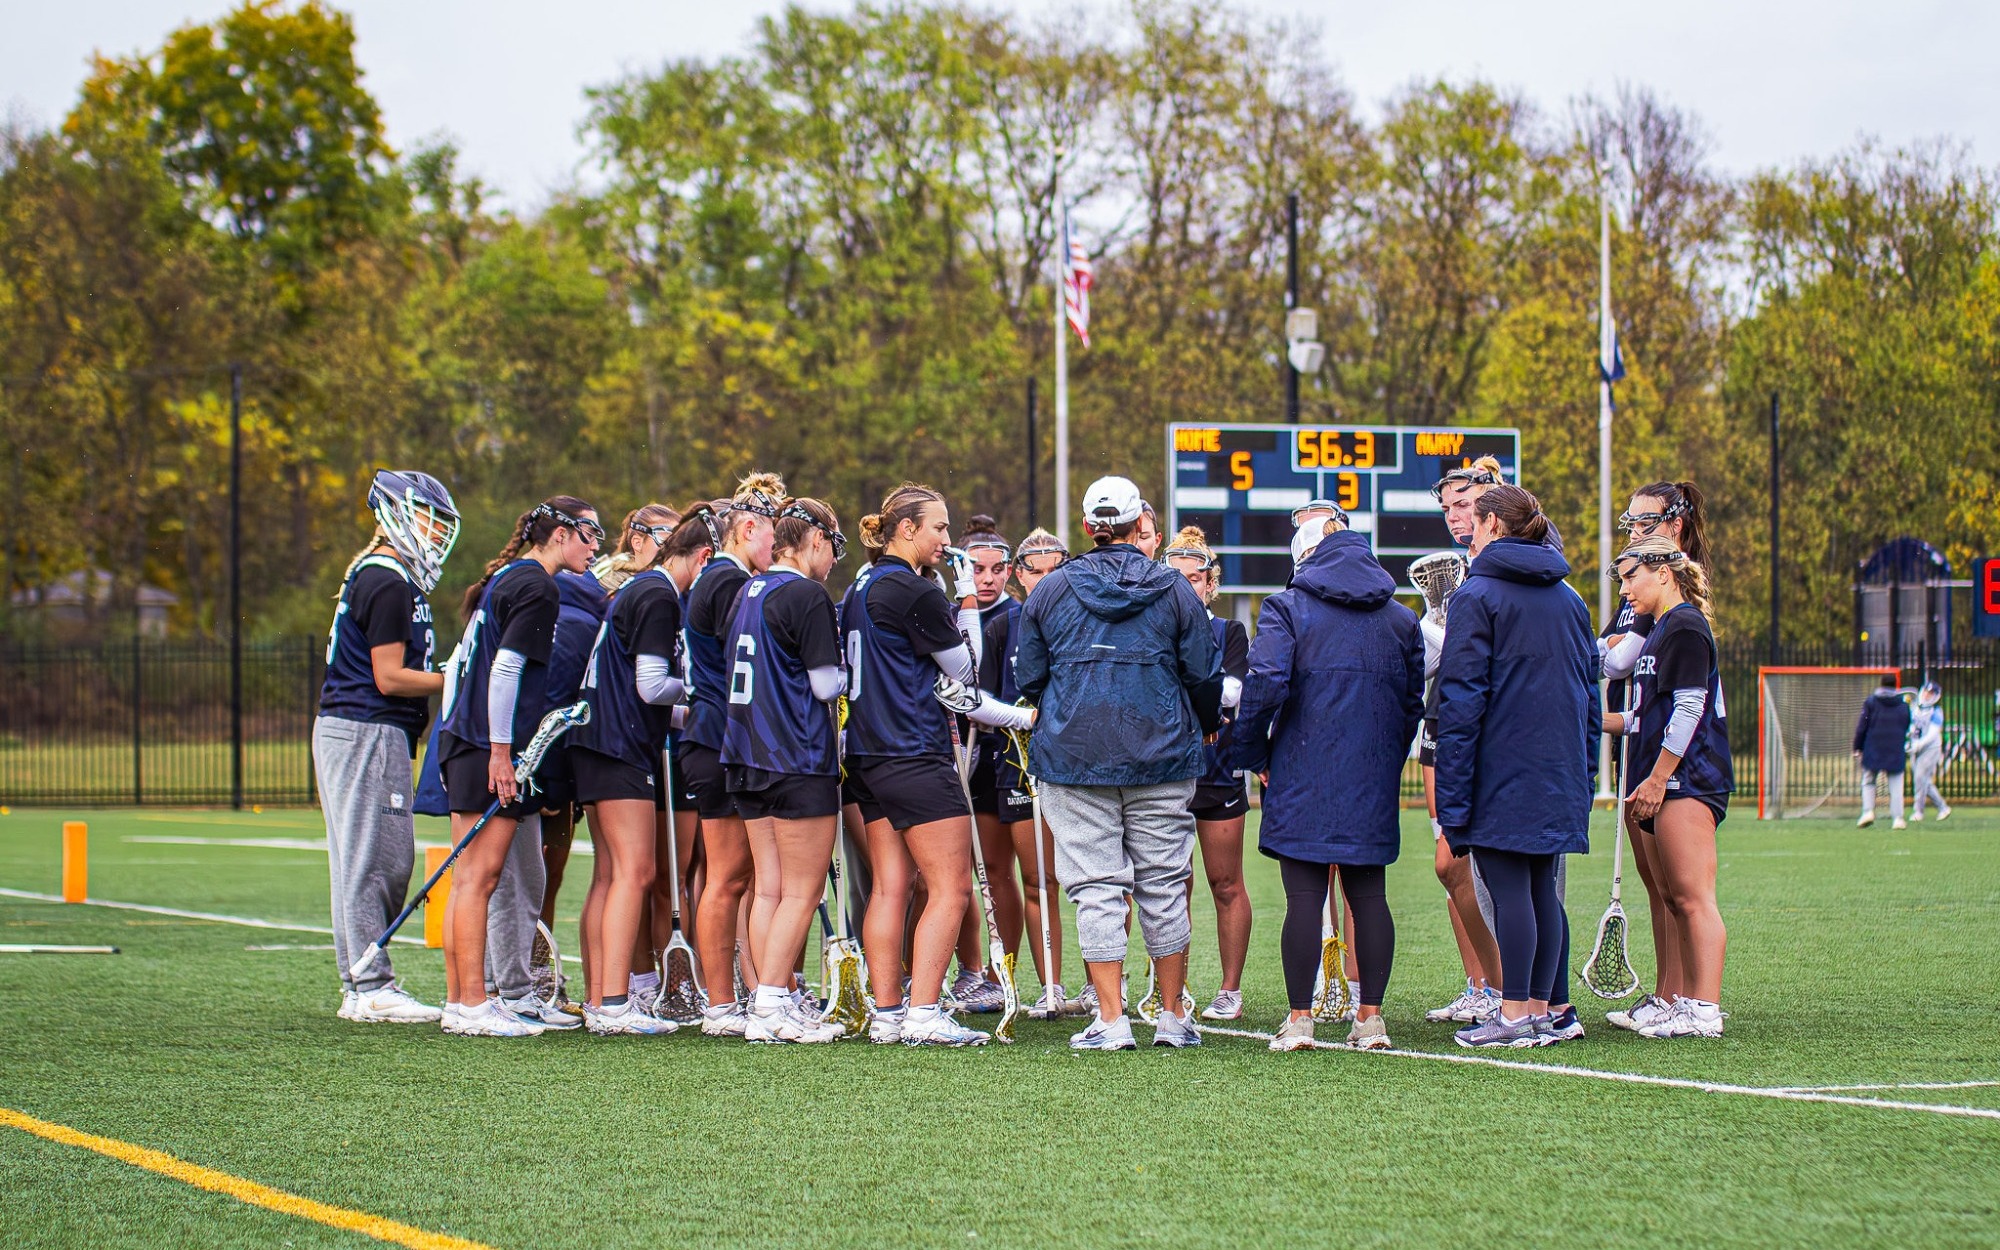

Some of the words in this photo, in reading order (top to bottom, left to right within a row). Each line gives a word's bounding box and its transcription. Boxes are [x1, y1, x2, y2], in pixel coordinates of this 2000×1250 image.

[1174, 428, 1221, 452] HOME
[1298, 430, 1375, 468] 56.3
[1415, 432, 1464, 456] AWAY
[1231, 451, 1254, 491] 5
[1338, 472, 1359, 511] 3
[729, 634, 755, 705] 6
[1007, 796, 1032, 806] DAWGS
